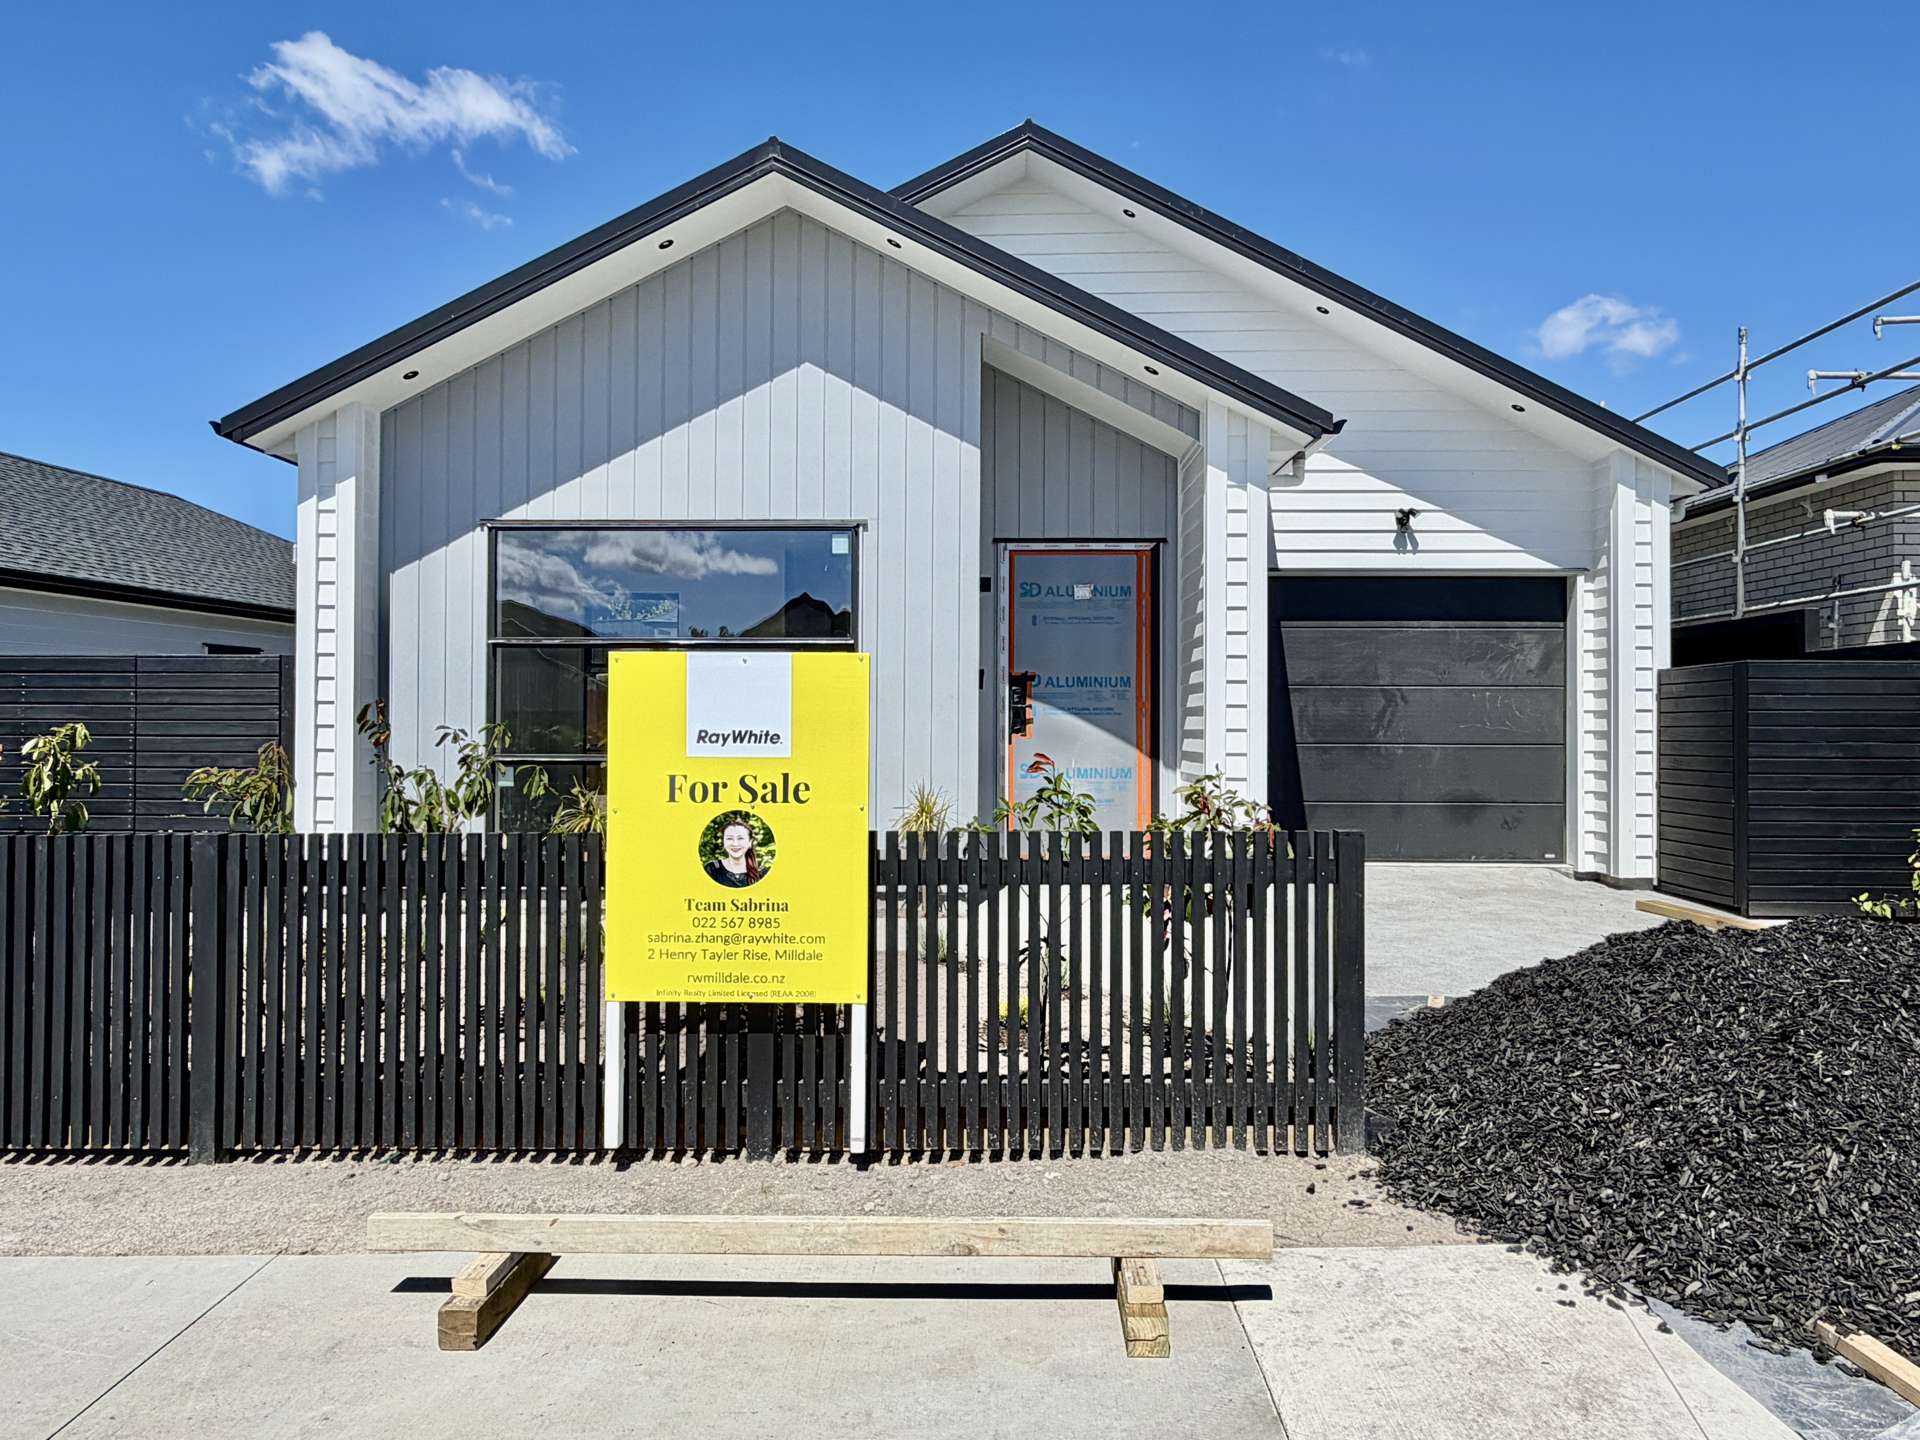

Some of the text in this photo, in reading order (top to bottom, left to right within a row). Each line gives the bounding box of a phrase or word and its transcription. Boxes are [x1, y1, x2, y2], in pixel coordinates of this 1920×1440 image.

[1019, 582, 1132, 598] SD ALUNIUM
[1045, 676, 1132, 688] ALUMINIUM
[666, 772, 811, 804] For Sale
[684, 898, 789, 913] Team Sabrina
[692, 917, 781, 929] 022 567 8985
[647, 932, 826, 946] sabrina.zhang@raywhite.com
[647, 949, 824, 963] 2 Henry Tayler Rise, Milldale
[687, 972, 786, 985] rwmilldale.co.nz
[708, 989, 734, 998] Limited
